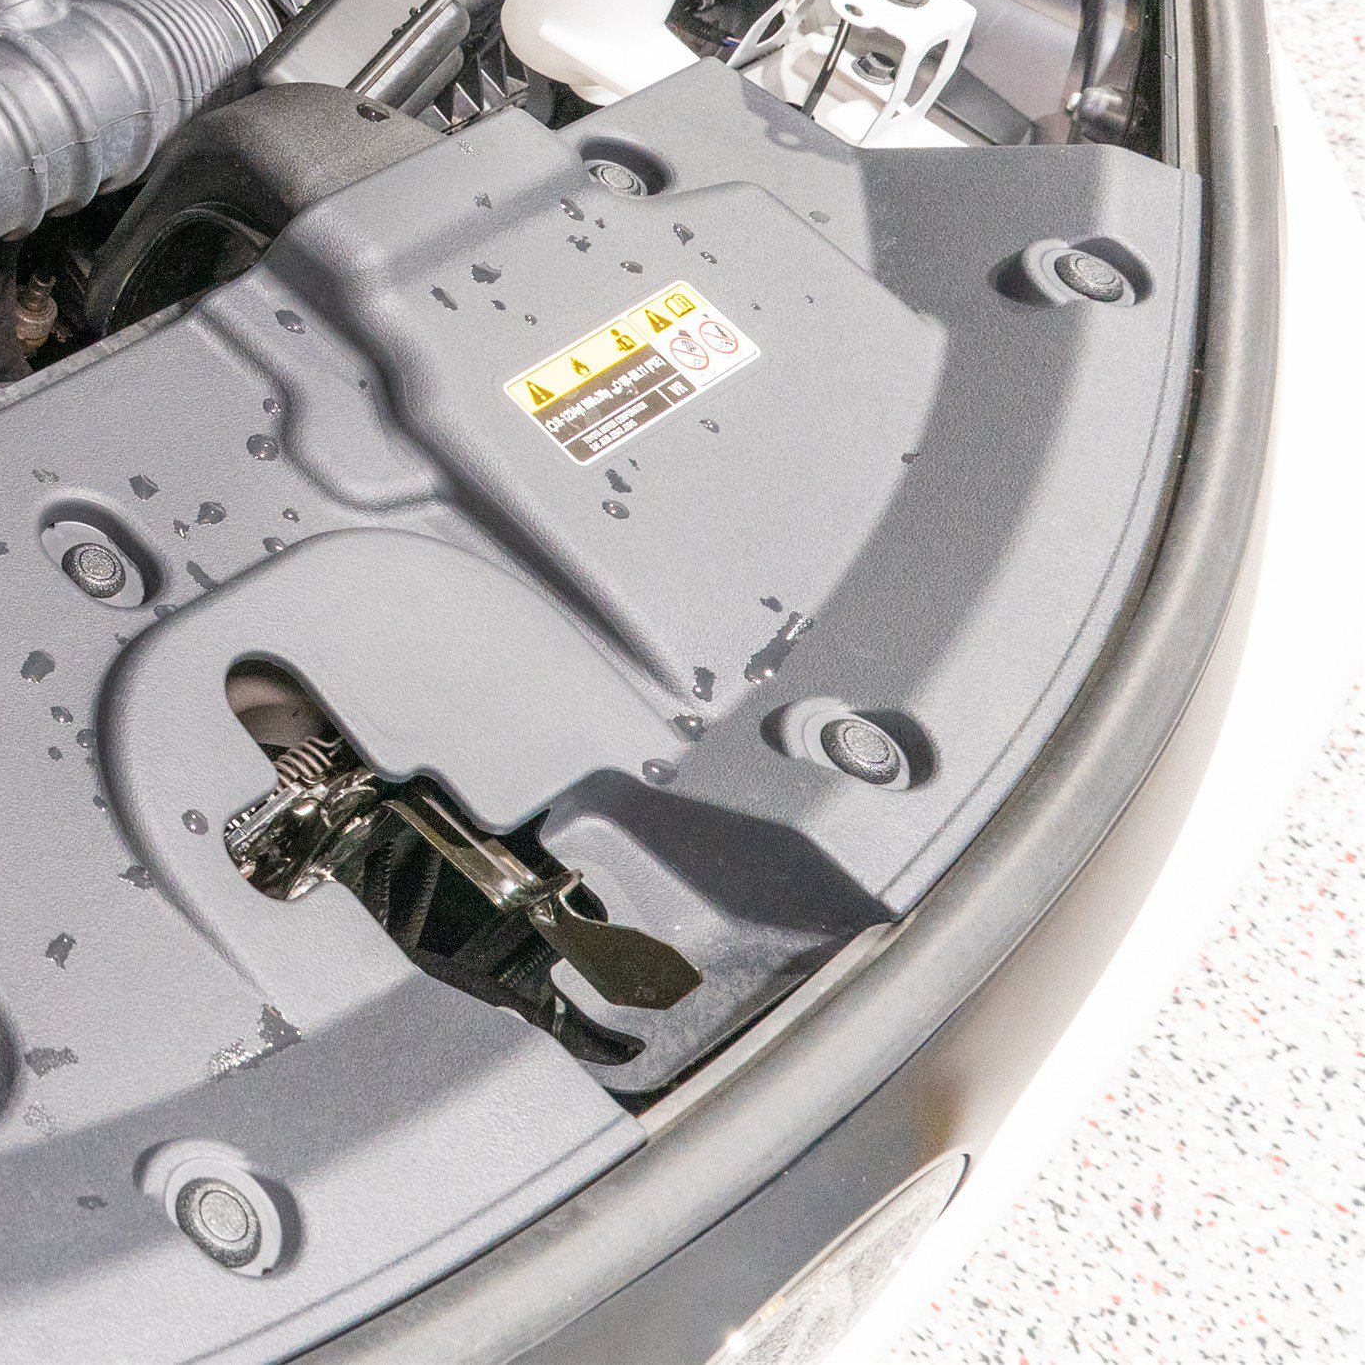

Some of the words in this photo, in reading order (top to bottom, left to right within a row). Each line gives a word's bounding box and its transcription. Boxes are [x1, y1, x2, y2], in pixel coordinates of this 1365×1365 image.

[668, 380, 689, 397] VR
[581, 429, 602, 444] TOYOTA
[598, 418, 618, 434] MOTOR
[613, 401, 649, 424] CORPORATION
